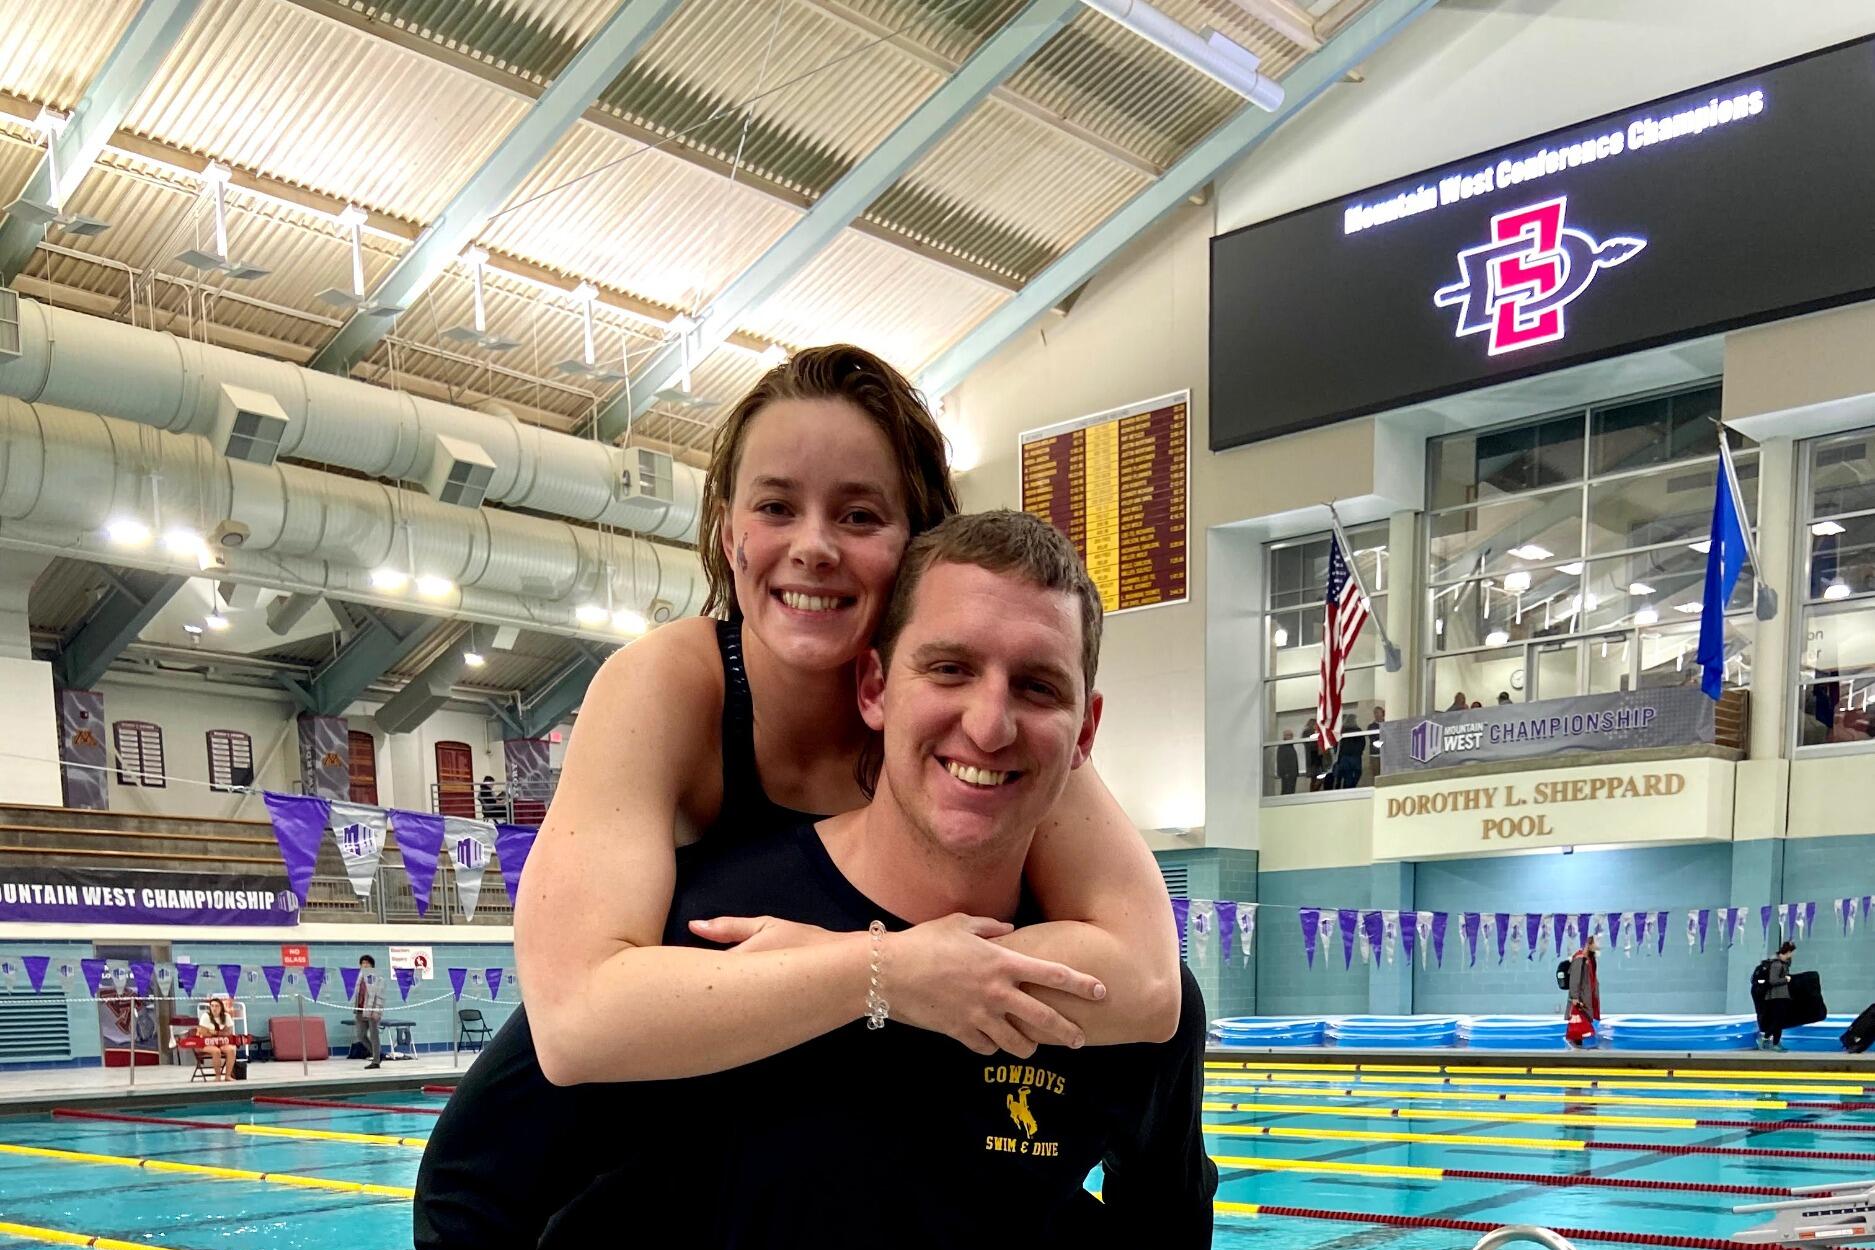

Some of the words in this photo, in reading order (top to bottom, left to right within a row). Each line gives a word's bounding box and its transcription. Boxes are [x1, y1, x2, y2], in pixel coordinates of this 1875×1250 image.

[1344, 187, 1437, 235] Mountain
[1439, 167, 1495, 206] West
[1496, 130, 1624, 190] Conference
[1627, 89, 1764, 151] Champions
[1444, 722, 1483, 737] MOUNTAIN
[1490, 707, 1656, 744] CHAMPIONSHIP
[1444, 733, 1482, 752] WEST
[1387, 787, 1498, 818] DOROTHY
[1504, 785, 1527, 806] L.
[1534, 773, 1685, 805] SHEPPARD
[1481, 814, 1553, 841] POOL
[0, 882, 78, 906] UNTAIN
[82, 886, 136, 908] WEST
[142, 888, 275, 911] CHAMPIONSHIP
[289, 948, 300, 956] NO
[984, 1065, 1066, 1094] COWBOYS
[985, 1135, 1017, 1153] SWIM
[1020, 1141, 1029, 1154] &
[1032, 1142, 1059, 1156] DIVE
